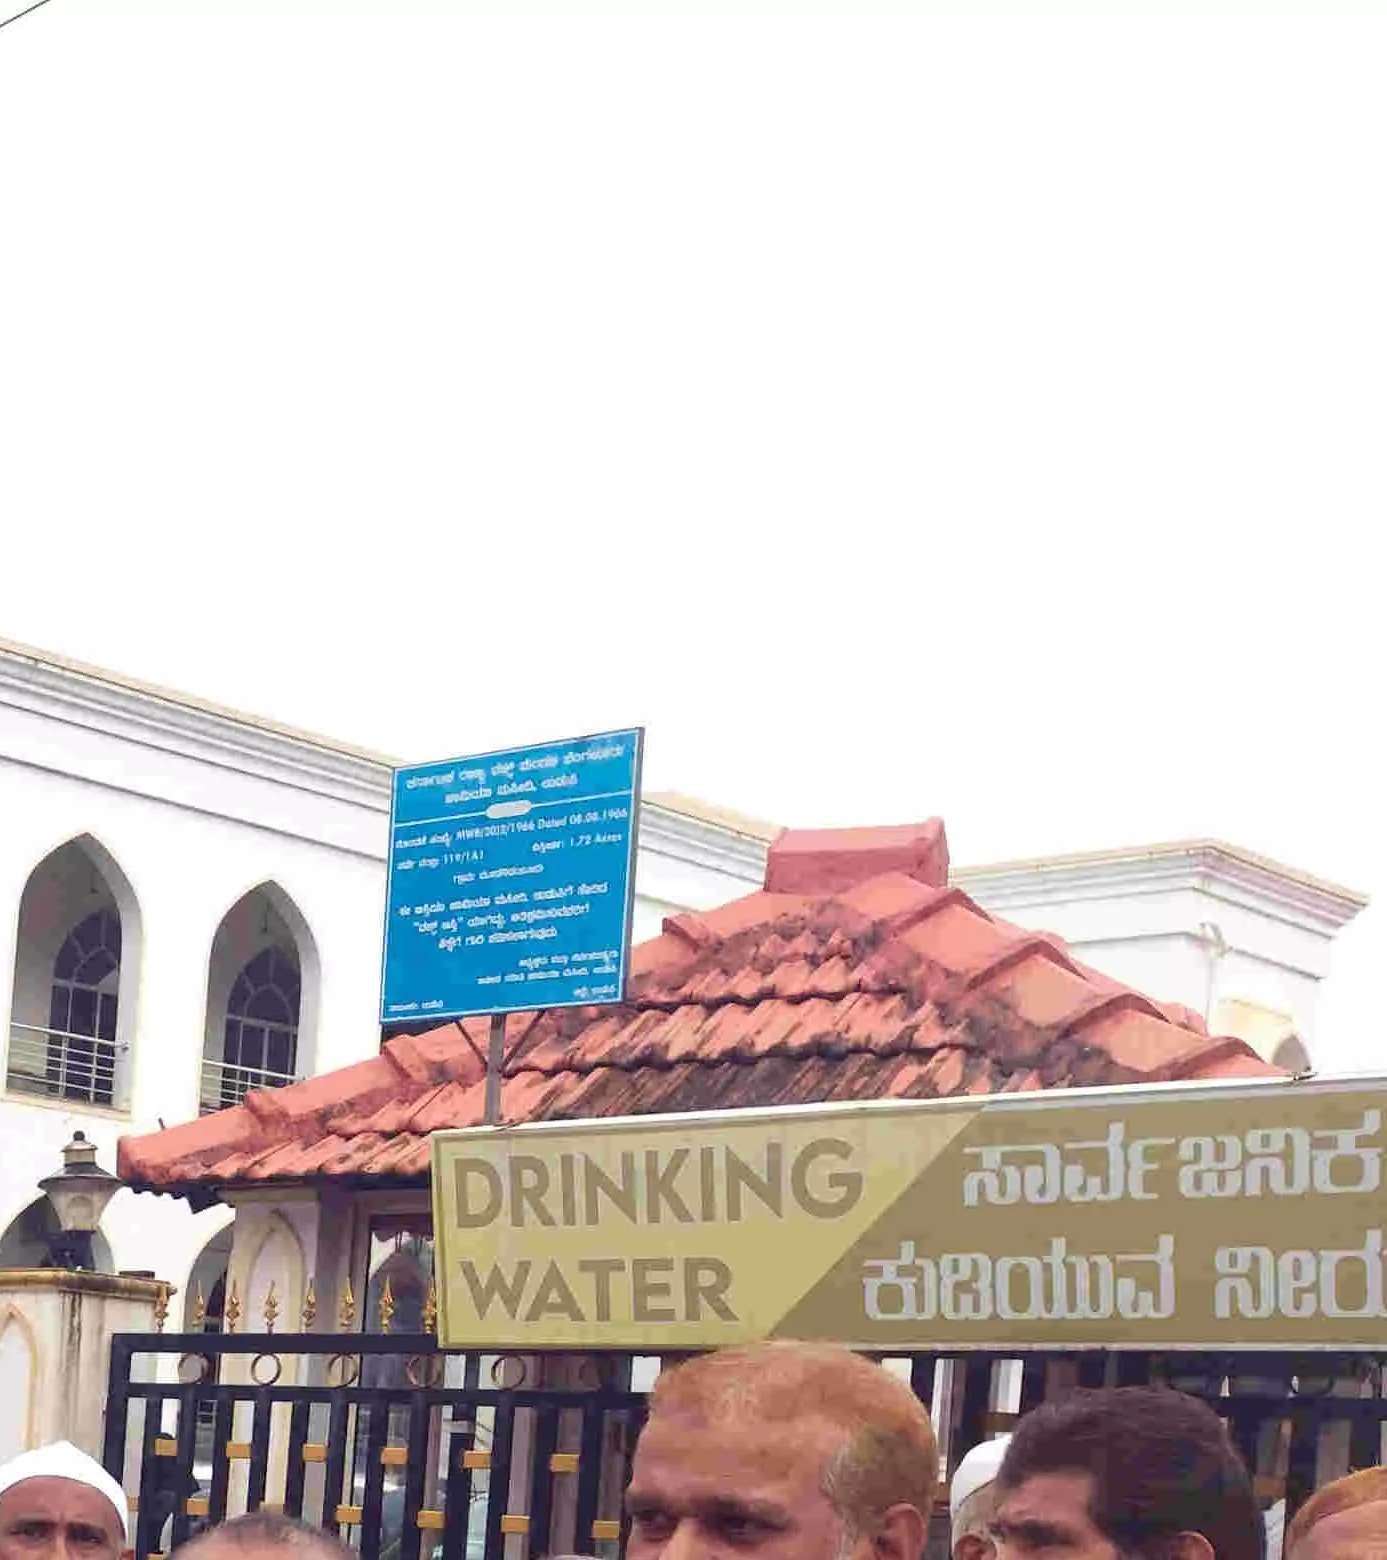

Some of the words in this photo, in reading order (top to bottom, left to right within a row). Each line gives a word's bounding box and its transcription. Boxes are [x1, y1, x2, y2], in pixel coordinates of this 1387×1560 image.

[454, 1138, 864, 1229] DRINKING
[962, 1108, 1383, 1207] ಸಾರ್ವಜನಿಕ
[459, 1256, 740, 1323] WATER
[863, 1233, 1176, 1320] ಕುಡಿಯುವ
